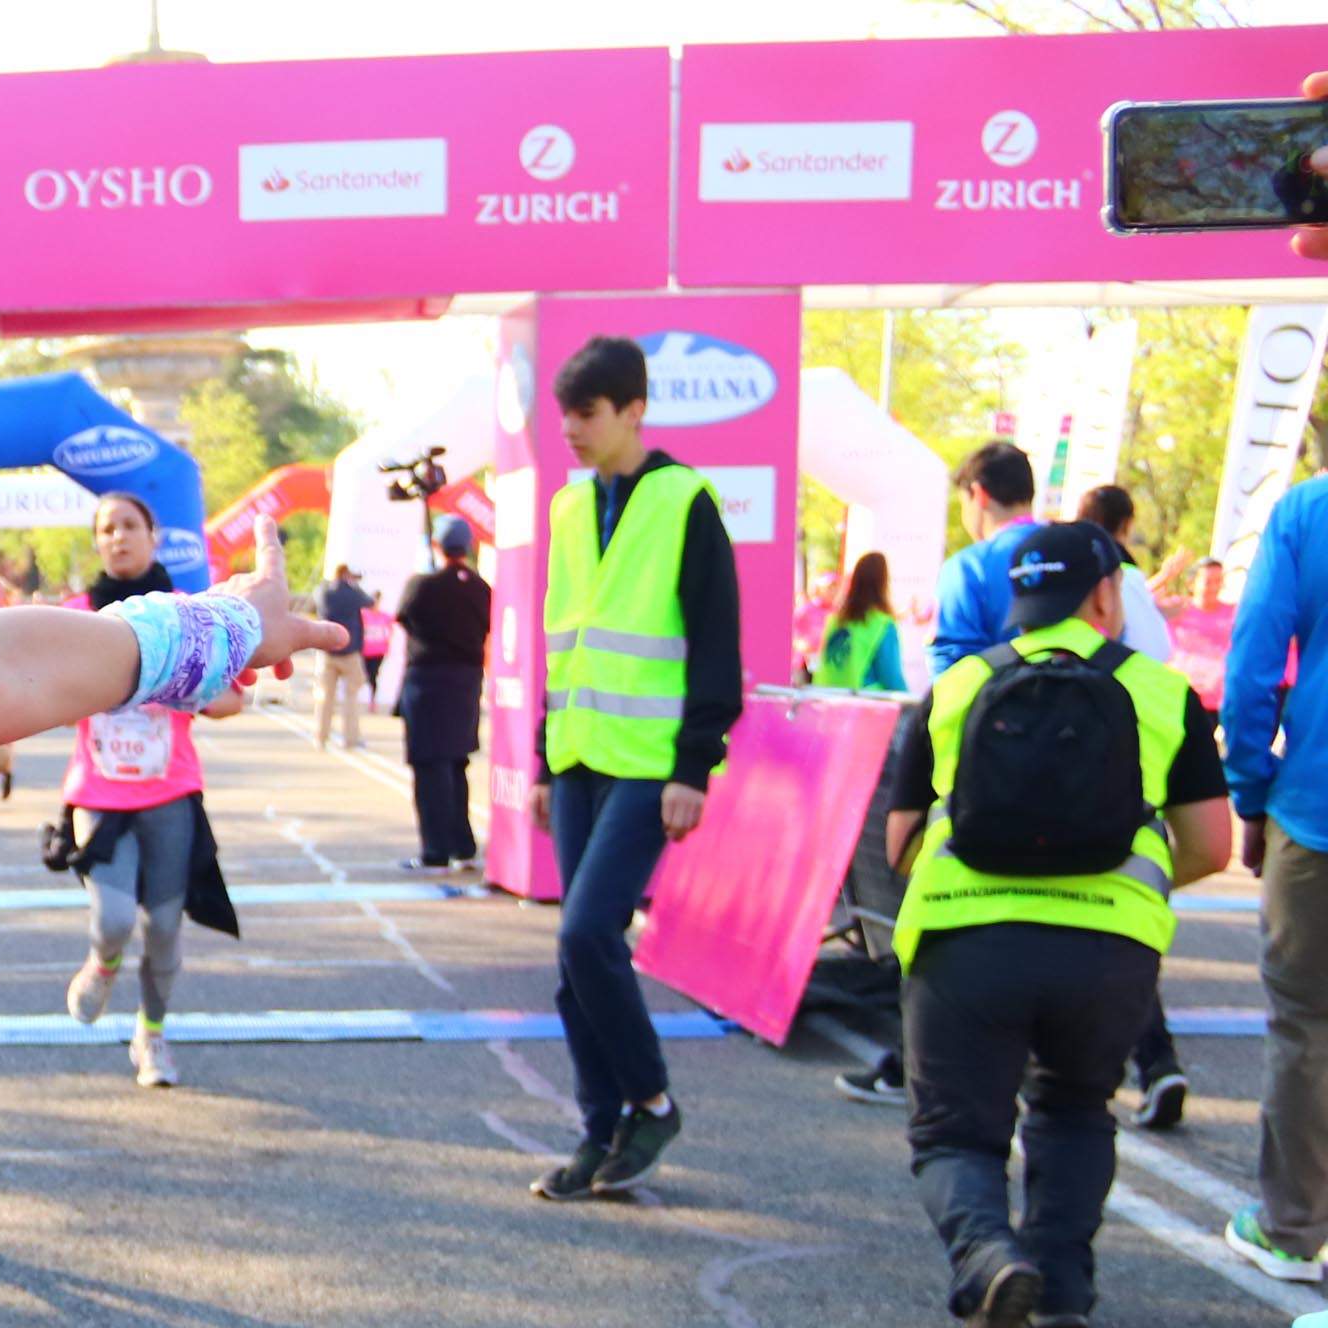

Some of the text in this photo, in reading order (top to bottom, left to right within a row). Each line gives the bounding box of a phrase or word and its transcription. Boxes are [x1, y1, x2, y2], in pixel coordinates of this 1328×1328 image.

[755, 149, 889, 176] Santander
[23, 163, 213, 212] OYSHO
[296, 164, 423, 192] Santander
[474, 192, 620, 225] ZURICH
[933, 178, 1082, 211] ZURICH
[647, 379, 761, 402] URIANA
